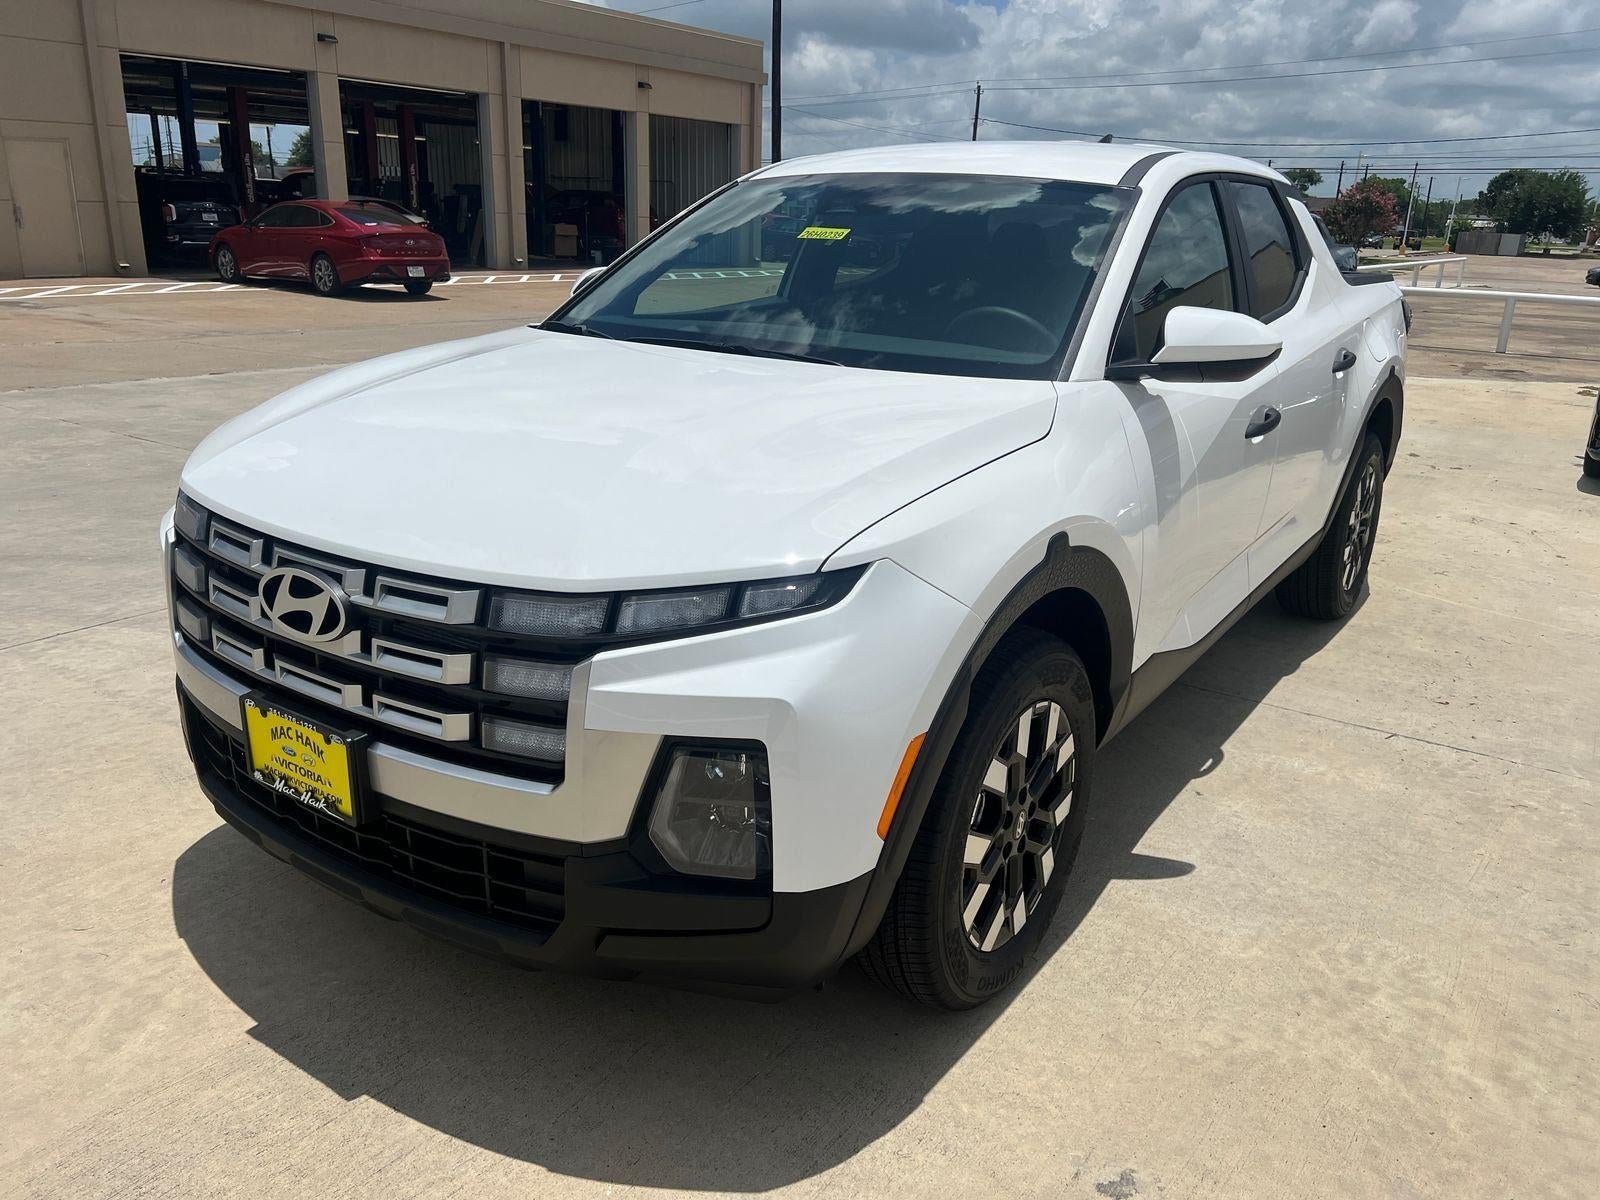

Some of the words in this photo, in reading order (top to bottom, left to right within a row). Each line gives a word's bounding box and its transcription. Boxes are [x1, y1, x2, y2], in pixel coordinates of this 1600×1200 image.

[801, 230, 845, 239] 26H0239
[270, 725, 293, 742] MAC
[295, 729, 326, 764] HAIK
[277, 757, 324, 783] VICTORIA
[273, 777, 296, 796] Mac
[977, 958, 1025, 991] KUMHO
